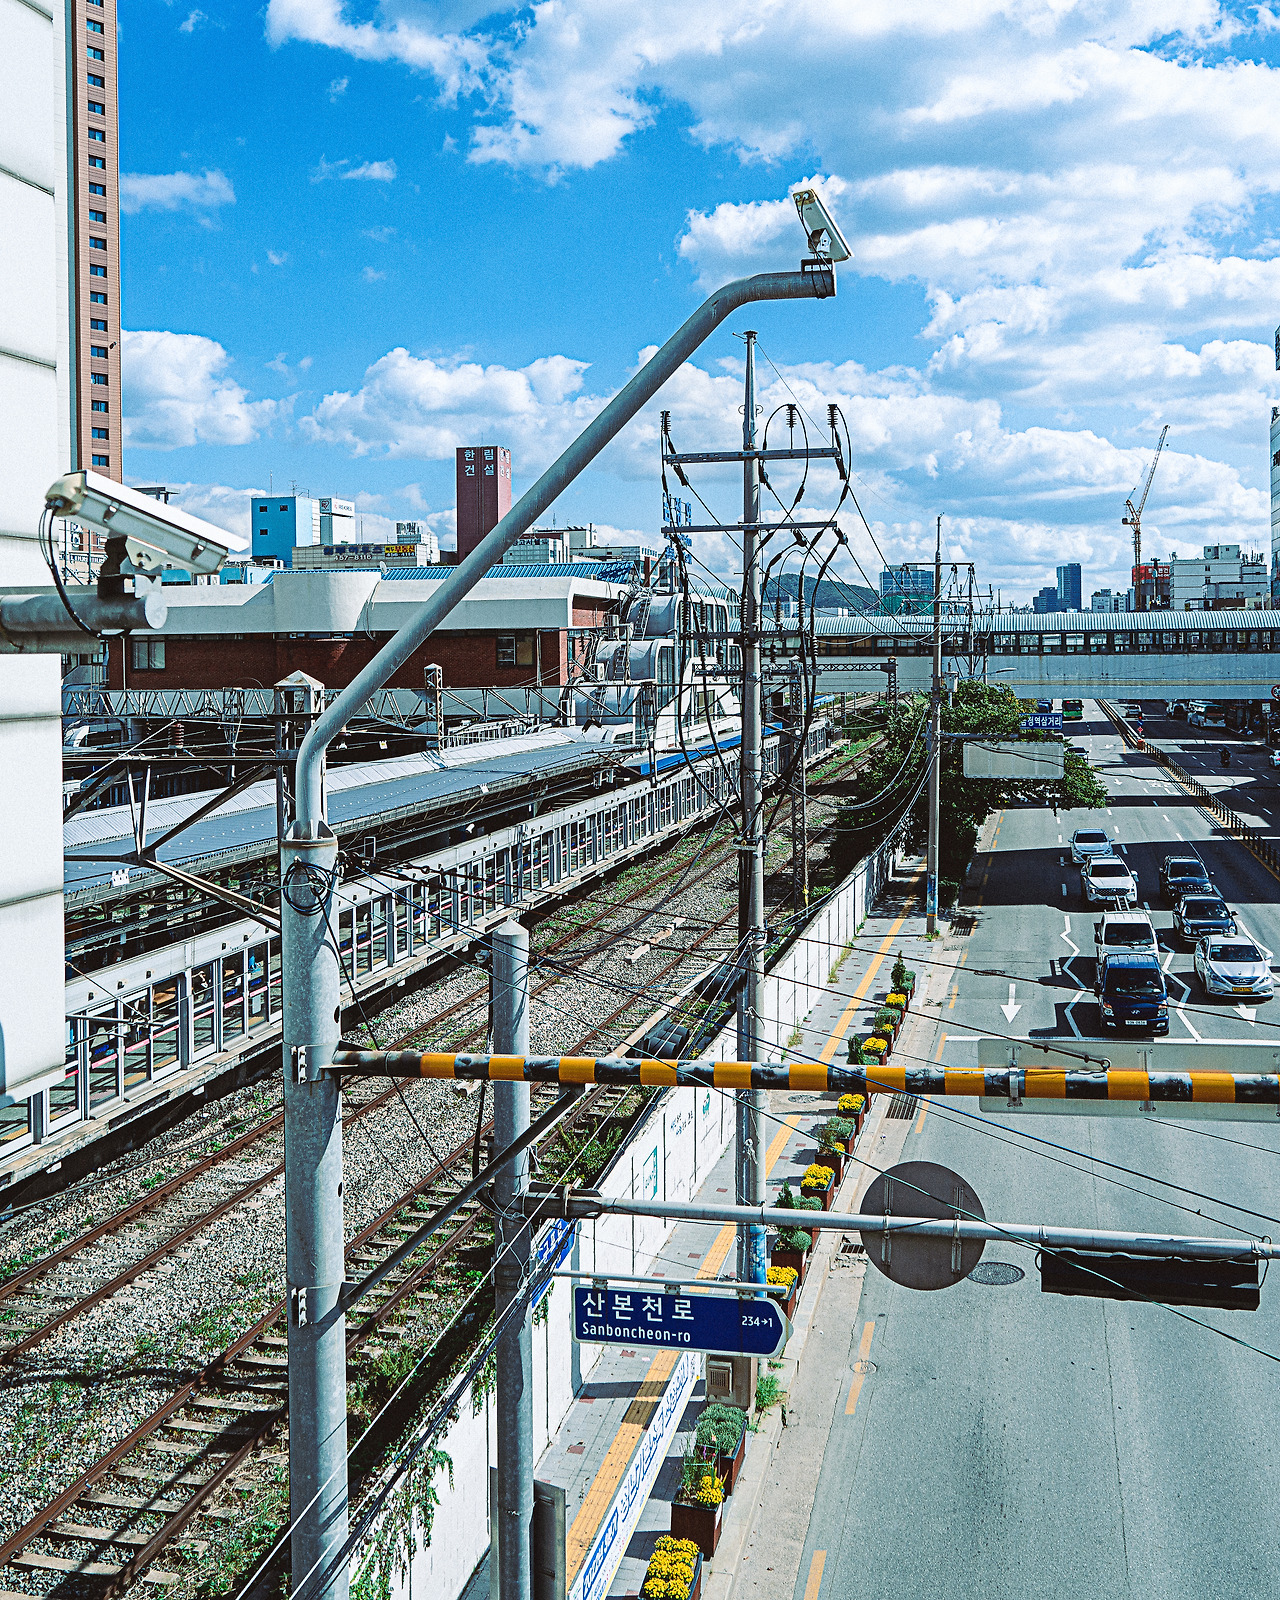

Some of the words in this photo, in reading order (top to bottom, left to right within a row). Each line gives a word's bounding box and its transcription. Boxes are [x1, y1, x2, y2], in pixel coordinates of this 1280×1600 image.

[464, 449, 494, 461] 한림
[464, 464, 494, 477] 건설
[582, 1293, 695, 1323] 산본천로
[741, 1315, 760, 1327] 234
[582, 1321, 691, 1343] Sanboncheon-ro
